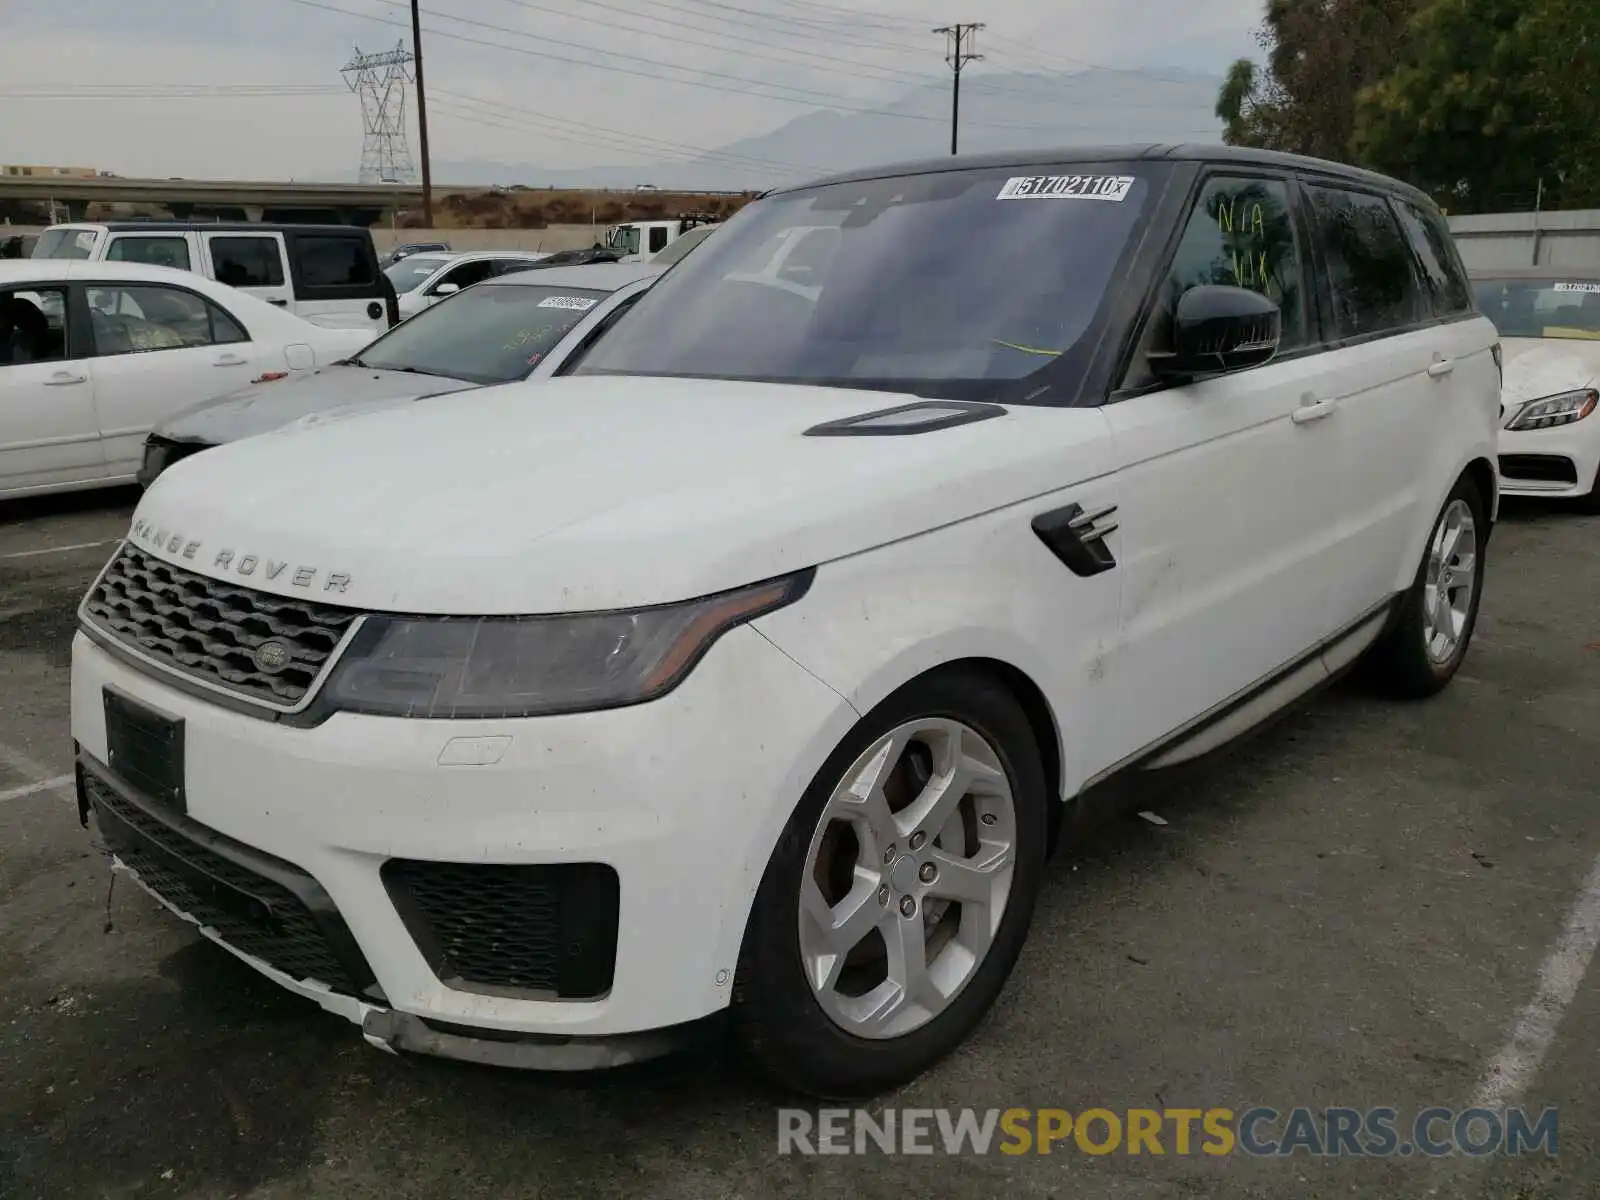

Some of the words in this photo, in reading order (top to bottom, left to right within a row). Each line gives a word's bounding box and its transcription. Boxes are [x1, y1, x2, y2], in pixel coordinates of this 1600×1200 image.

[1016, 176, 1113, 195] 51702110
[133, 517, 201, 559] RANGE
[214, 548, 353, 593] ROVER
